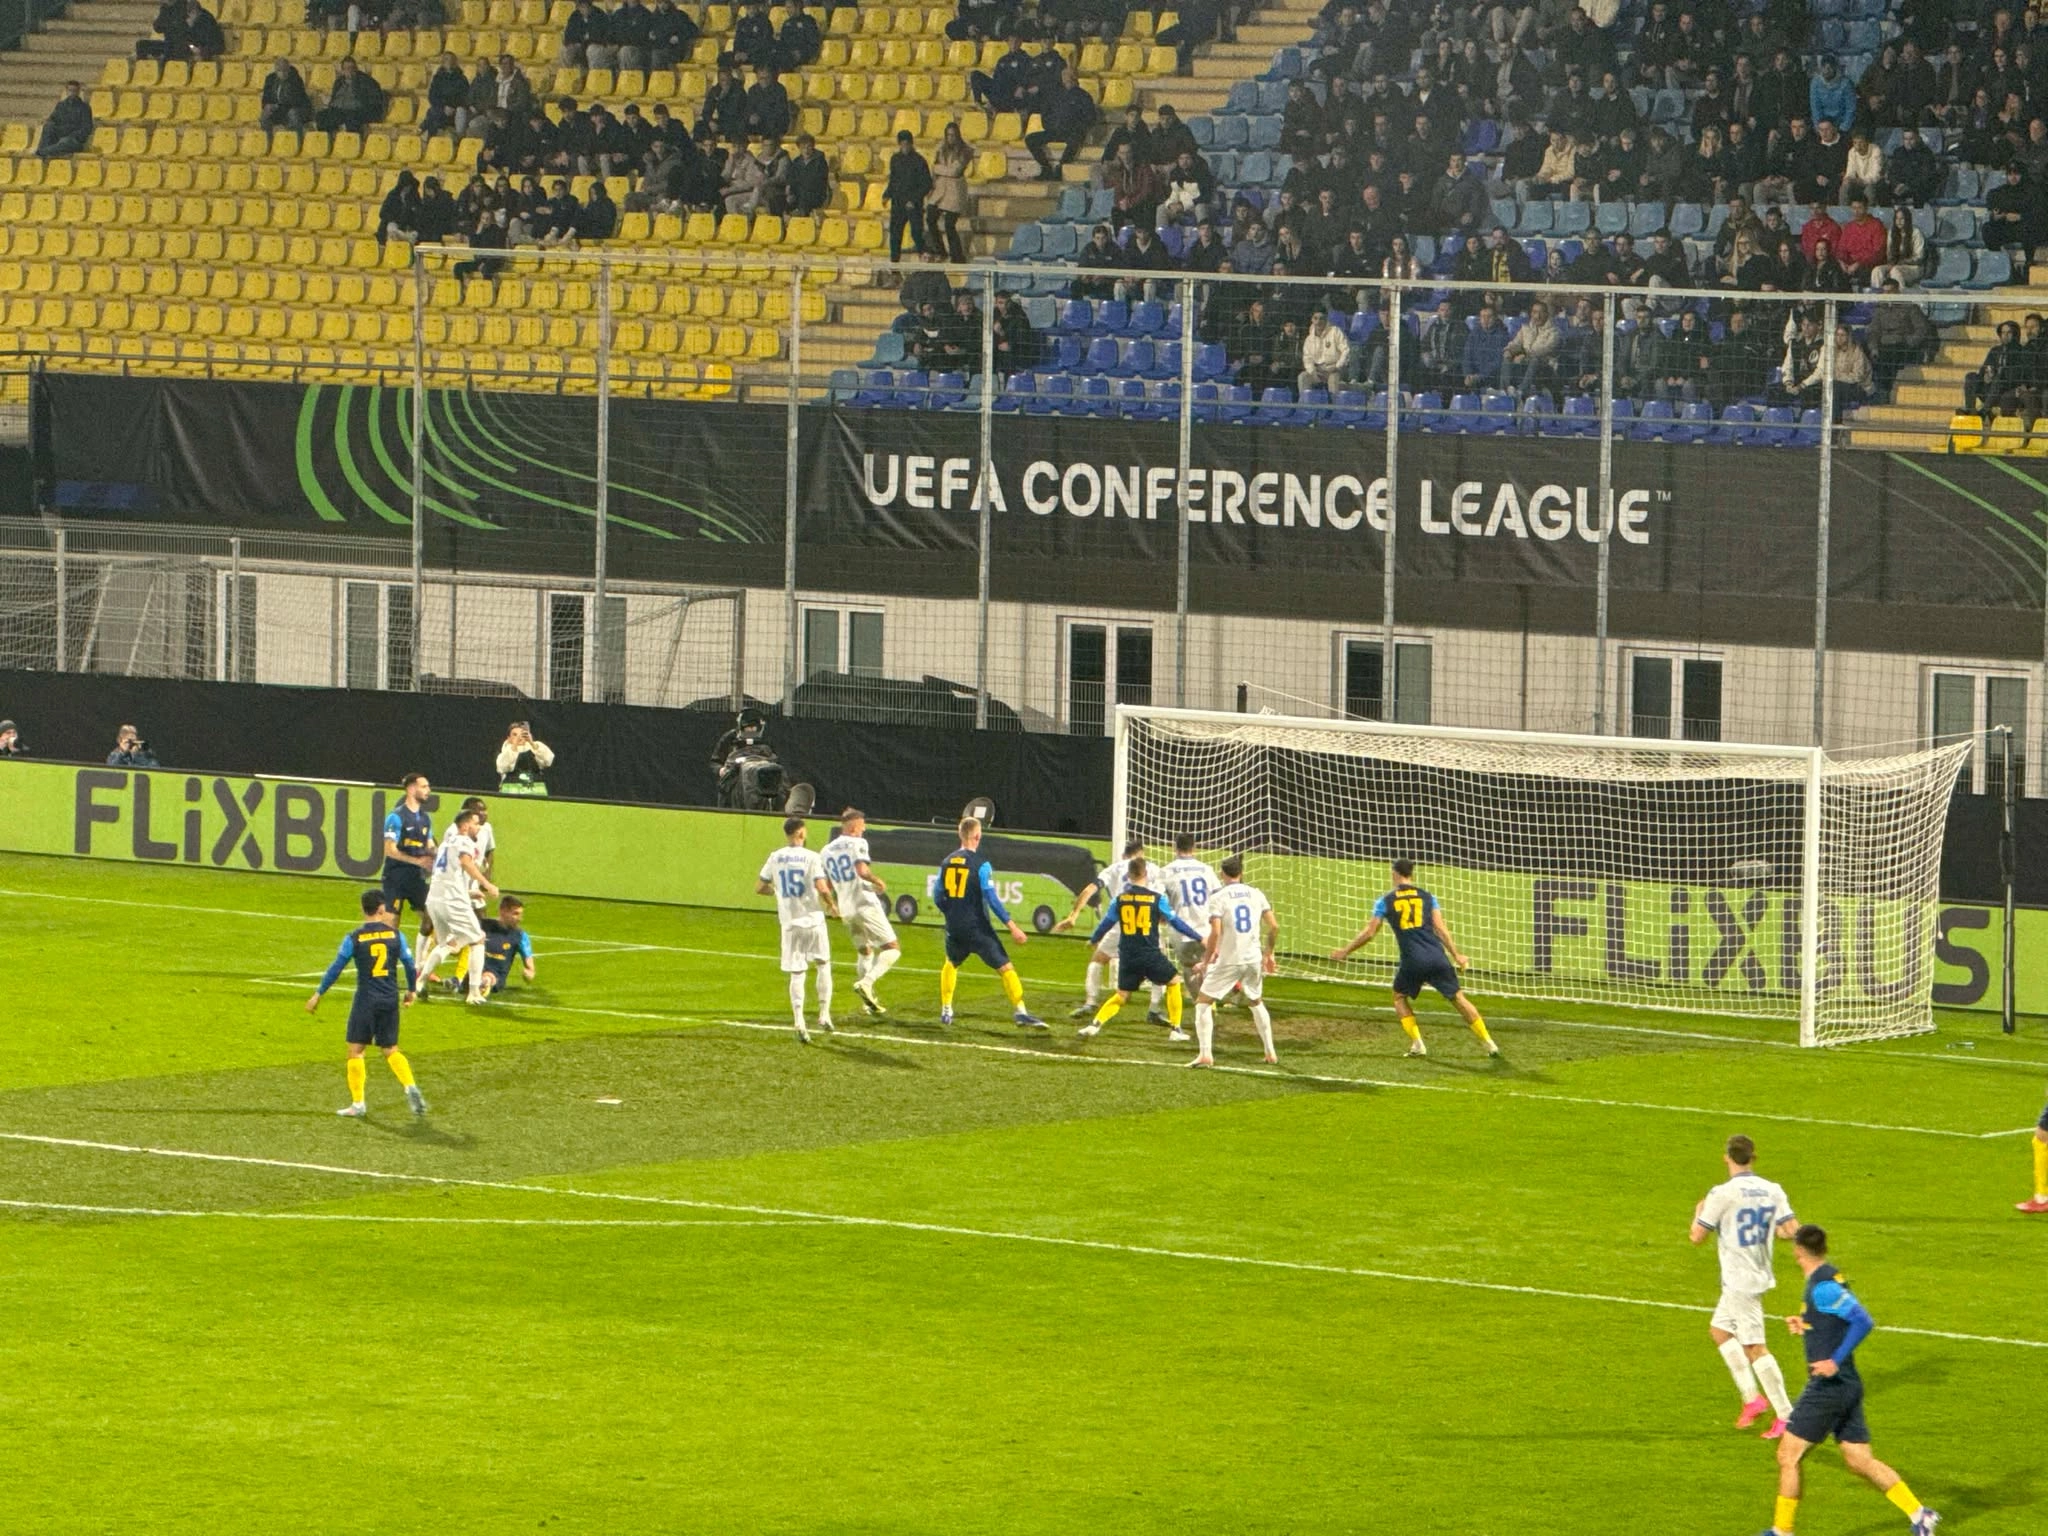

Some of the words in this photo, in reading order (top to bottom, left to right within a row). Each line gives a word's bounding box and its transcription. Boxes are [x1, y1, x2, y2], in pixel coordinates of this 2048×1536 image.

[864, 454, 1007, 512] UEFA
[1022, 460, 1391, 532] CONFERENCE
[1420, 479, 1650, 544] LEAGUE
[75, 769, 440, 877] FLiXBU
[778, 868, 806, 898] 15
[826, 853, 856, 882] 32
[944, 867, 970, 898] 47
[1179, 876, 1208, 907] 19
[1120, 904, 1152, 936] 94
[1234, 904, 1252, 933] 8
[1393, 898, 1423, 930] 27
[370, 943, 389, 977] 2
[1736, 1206, 1777, 1247] 25
